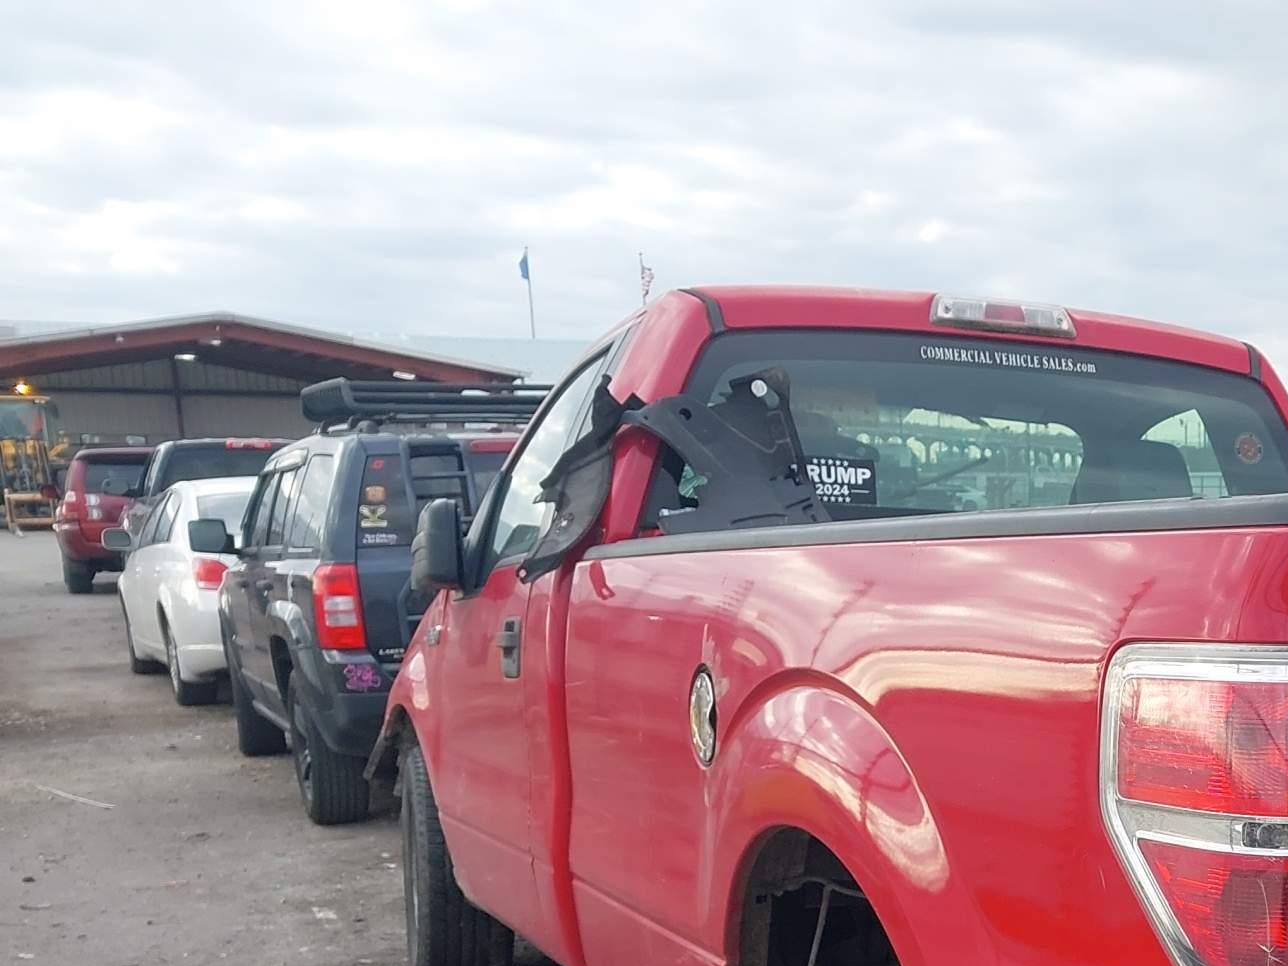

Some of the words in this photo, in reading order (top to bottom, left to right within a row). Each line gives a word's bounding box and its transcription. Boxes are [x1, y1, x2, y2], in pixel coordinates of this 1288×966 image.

[920, 345, 993, 364] COMMERCIAL
[995, 352, 1041, 369] VEHICLE
[1043, 356, 1097, 374] SALES.com
[791, 463, 872, 485] RUMP
[815, 483, 850, 496] 2024
